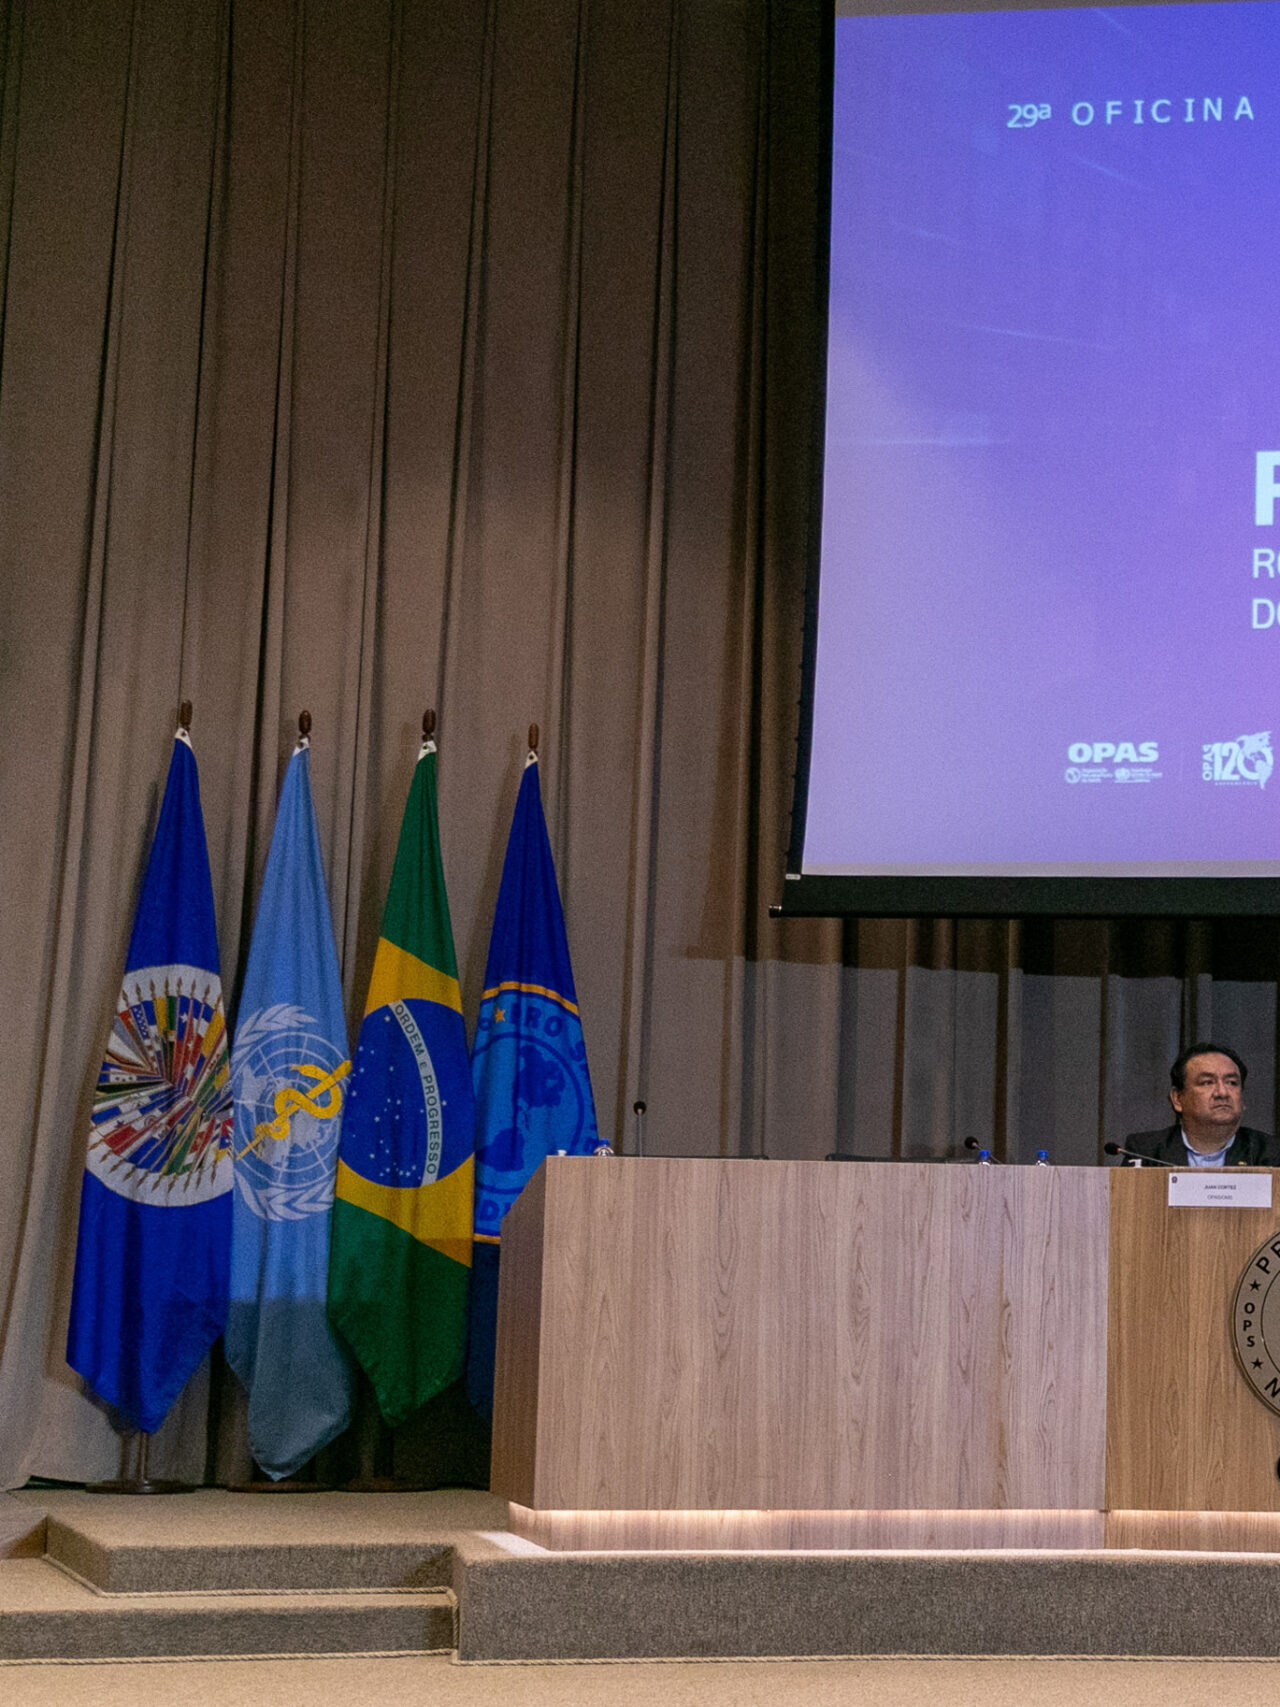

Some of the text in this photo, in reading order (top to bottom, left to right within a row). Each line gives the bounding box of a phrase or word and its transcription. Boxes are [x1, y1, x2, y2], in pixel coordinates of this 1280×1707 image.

[1072, 96, 1254, 127] OFICINA
[1067, 741, 1160, 764] OPAS
[394, 1004, 425, 1056] ORDEM
[422, 1074, 441, 1175] PROGRESSO
[1242, 1301, 1256, 1349] OPS
